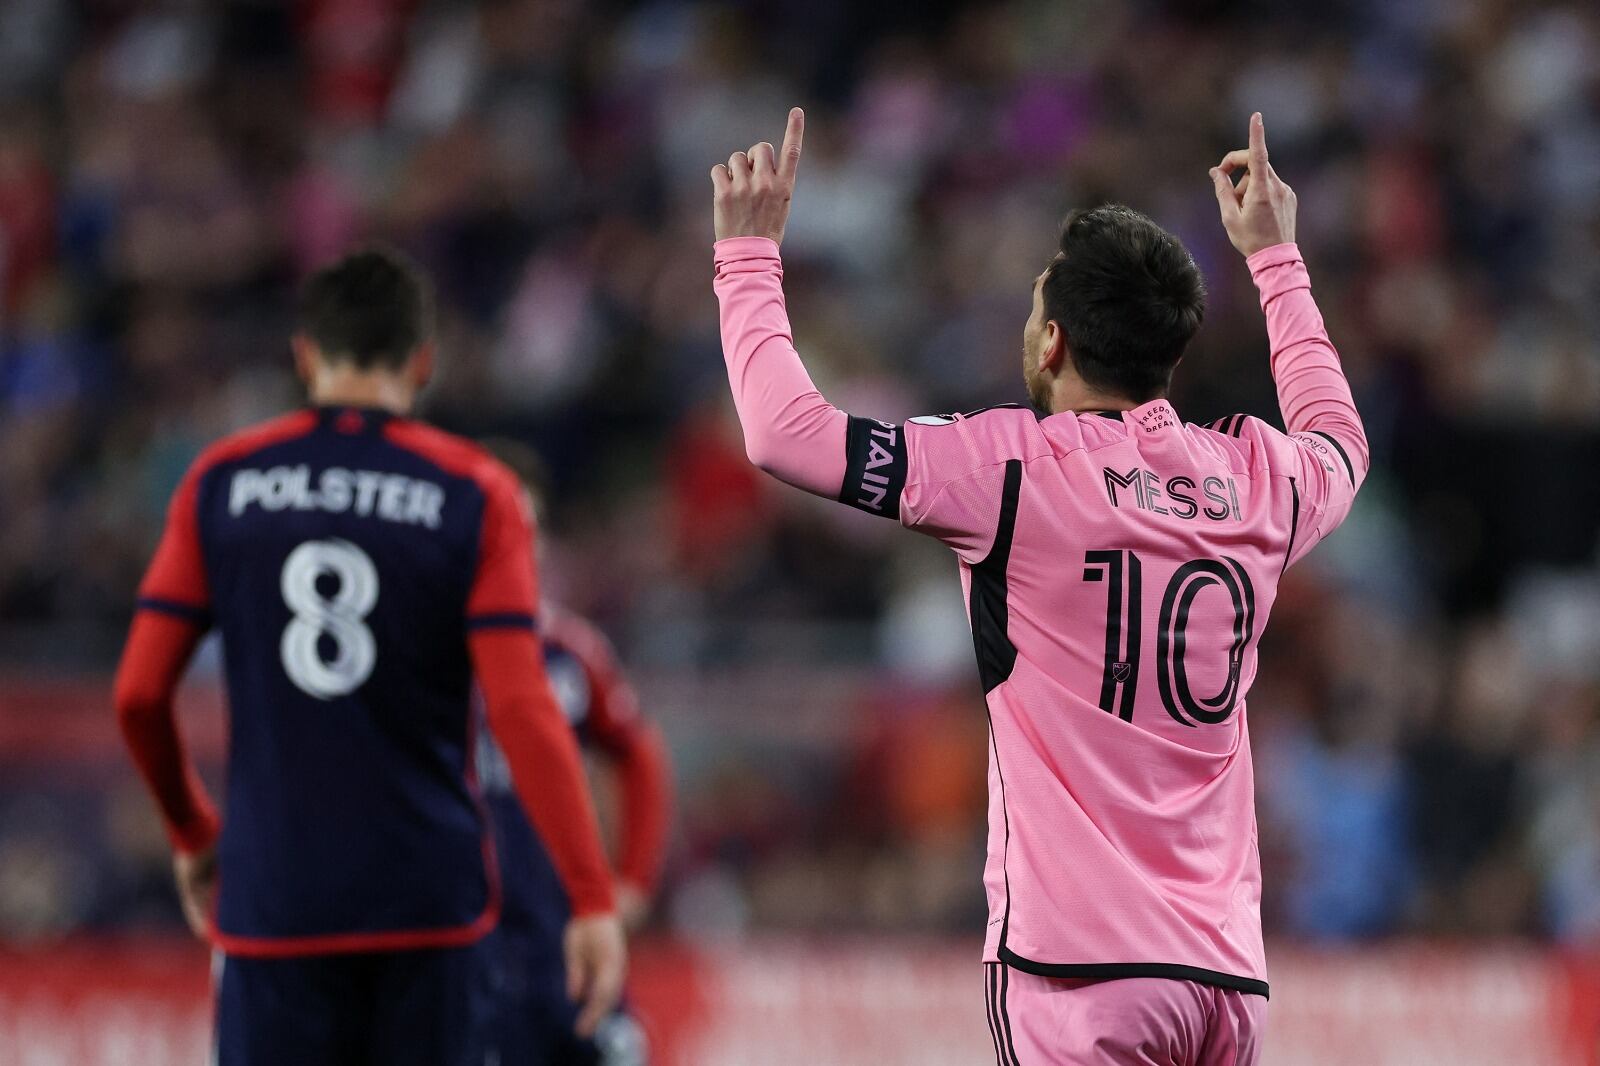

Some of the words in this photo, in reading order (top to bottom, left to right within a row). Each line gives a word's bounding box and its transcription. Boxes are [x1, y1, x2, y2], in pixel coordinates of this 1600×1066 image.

[1139, 406, 1173, 426] FREEDO
[1153, 414, 1163, 422] TO
[228, 463, 445, 530] POLSTER
[1103, 466, 1242, 521] MESSI
[280, 537, 380, 700] 8
[1083, 549, 1255, 728] 10
